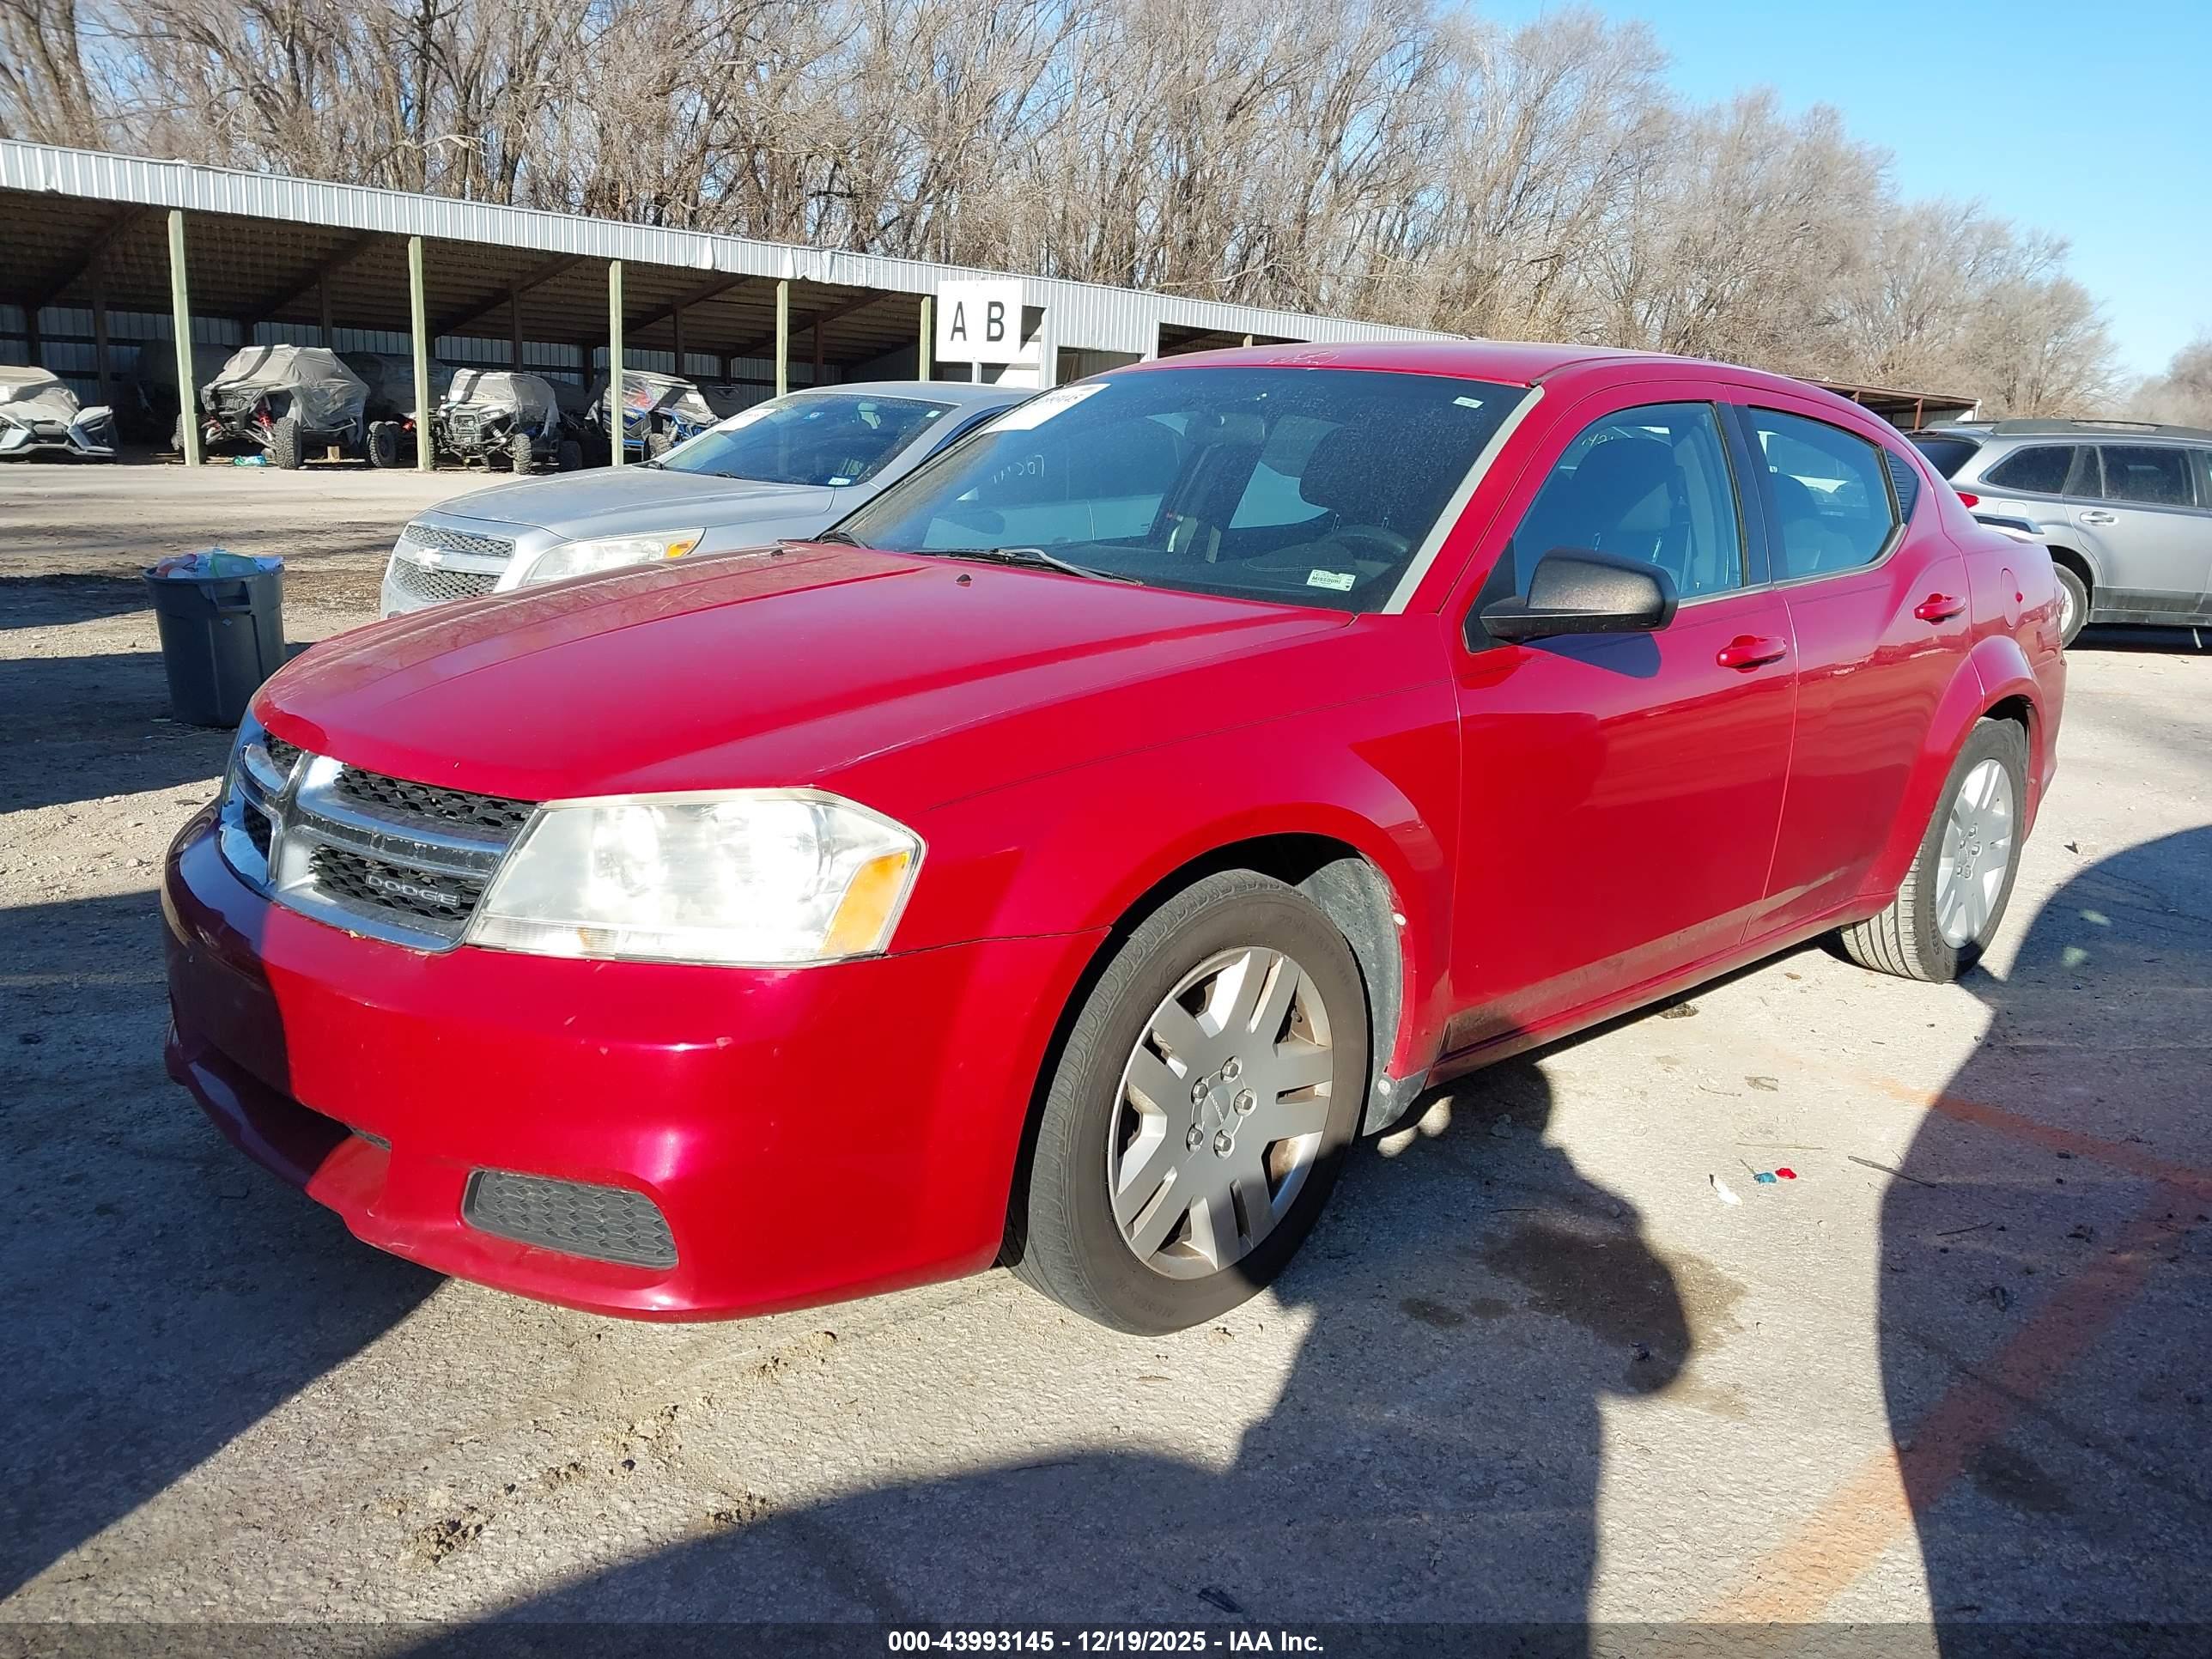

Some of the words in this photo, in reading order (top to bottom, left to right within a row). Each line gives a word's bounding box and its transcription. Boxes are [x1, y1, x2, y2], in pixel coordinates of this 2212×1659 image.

[951, 301, 967, 342] A
[986, 301, 1005, 342] B
[368, 875, 458, 907] DODGE
